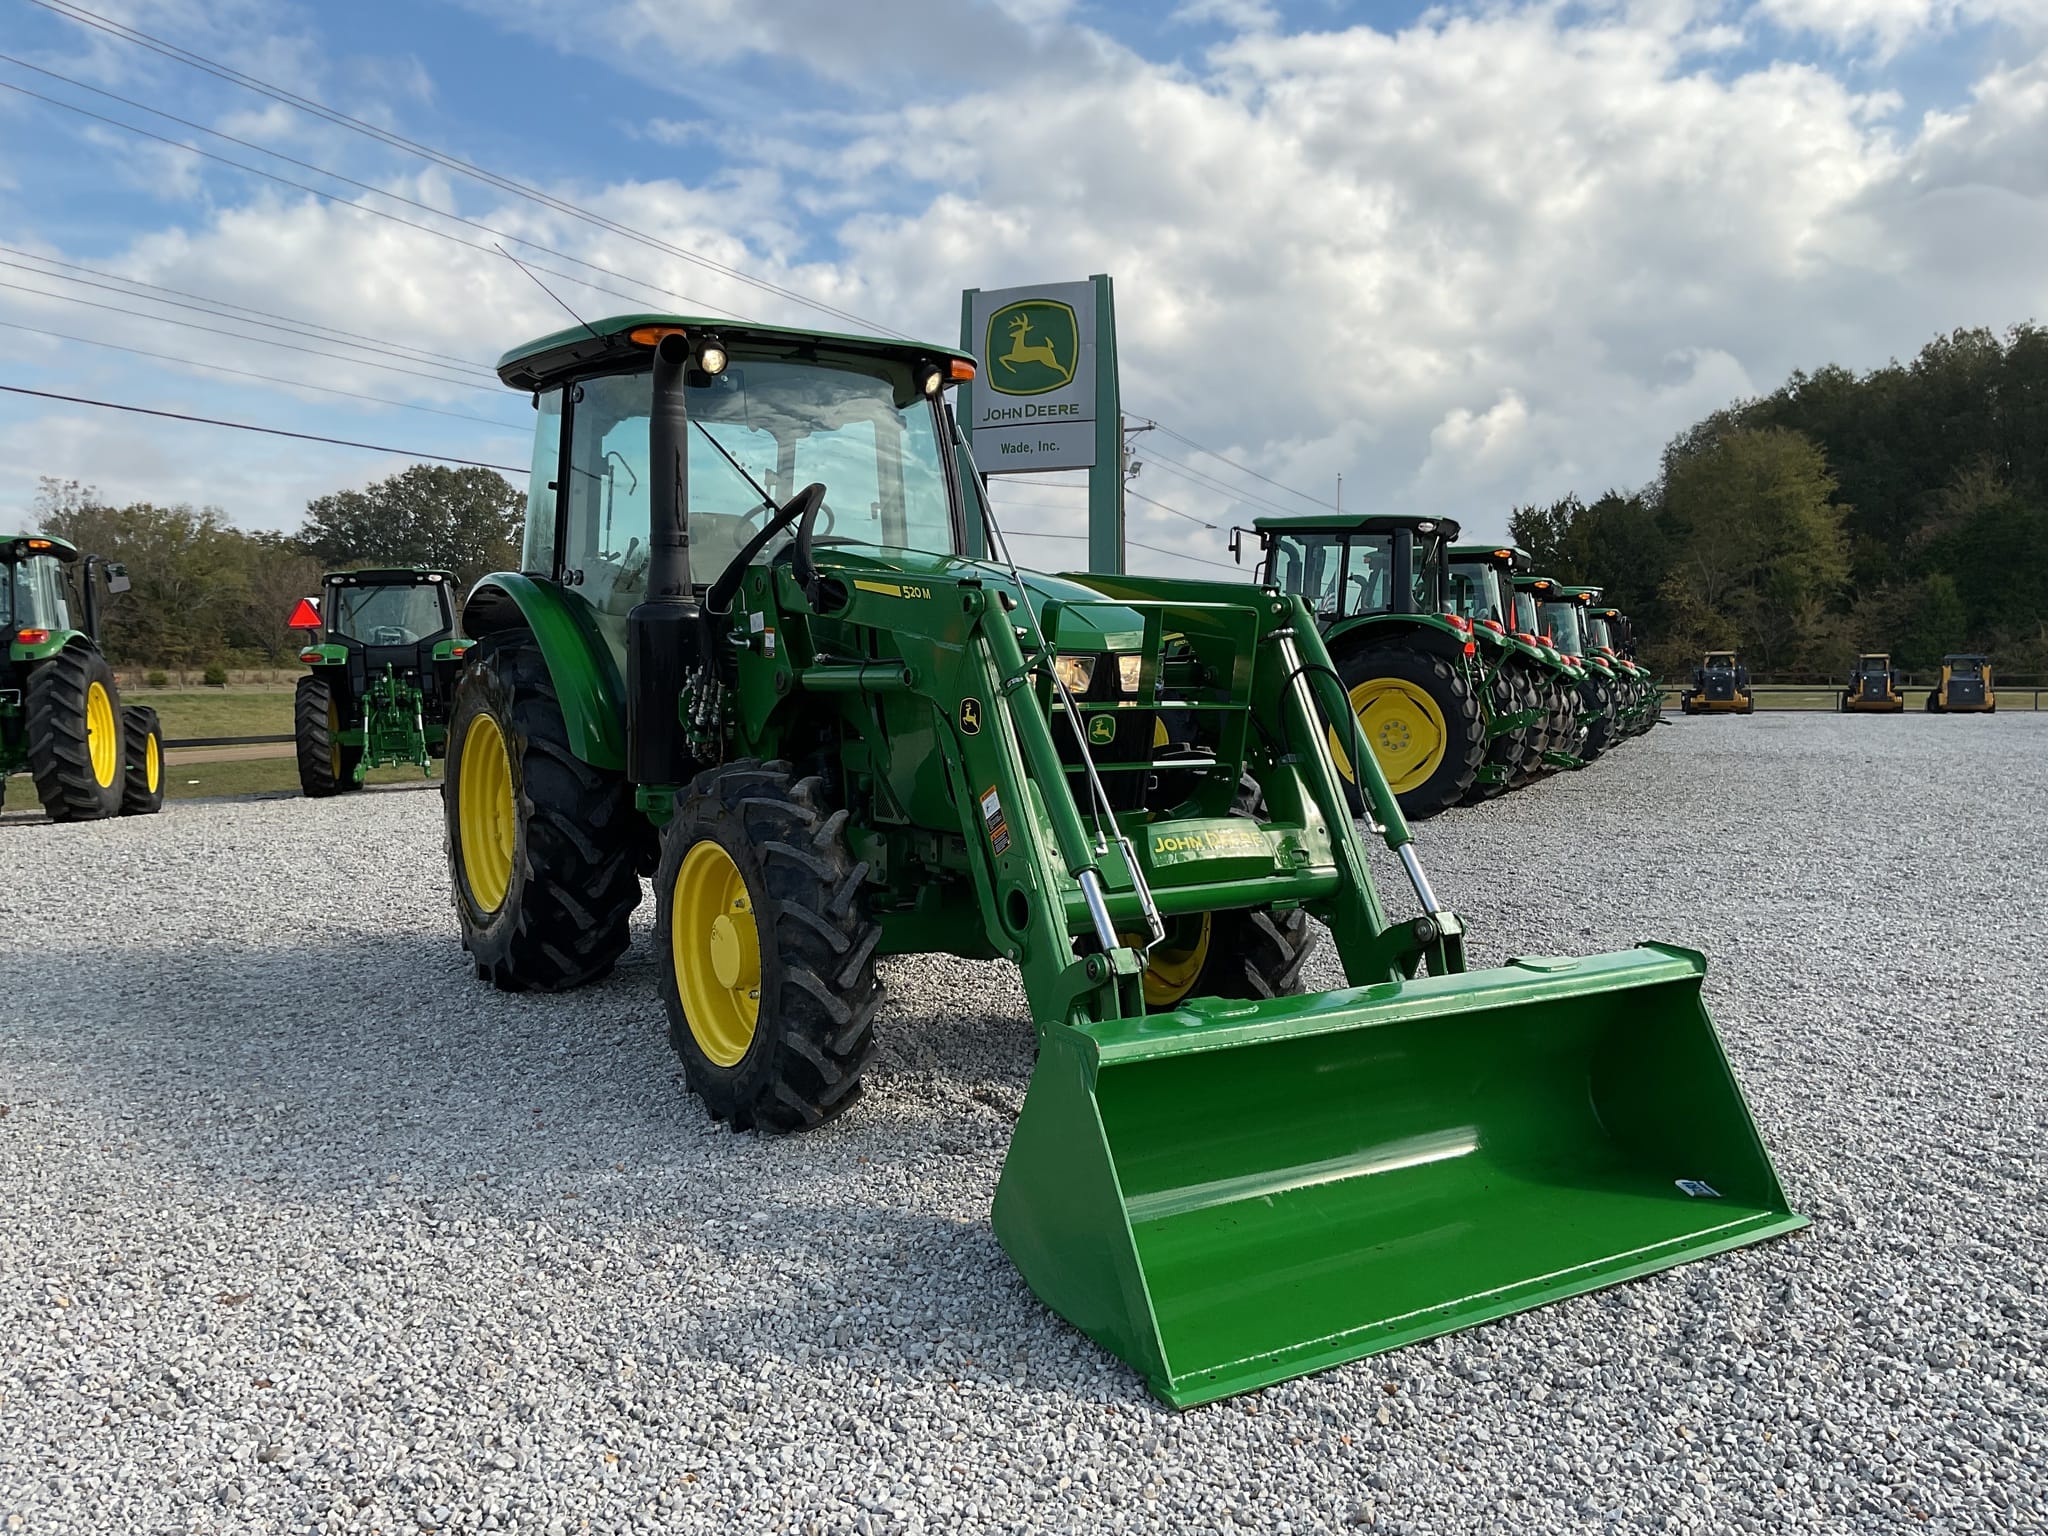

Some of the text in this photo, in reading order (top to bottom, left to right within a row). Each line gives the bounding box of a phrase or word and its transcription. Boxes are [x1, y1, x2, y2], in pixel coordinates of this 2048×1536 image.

[983, 403, 1079, 421] JOHN DEERE
[1001, 440, 1060, 455] Wade, Inc.
[1155, 837, 1203, 853] JOHN
